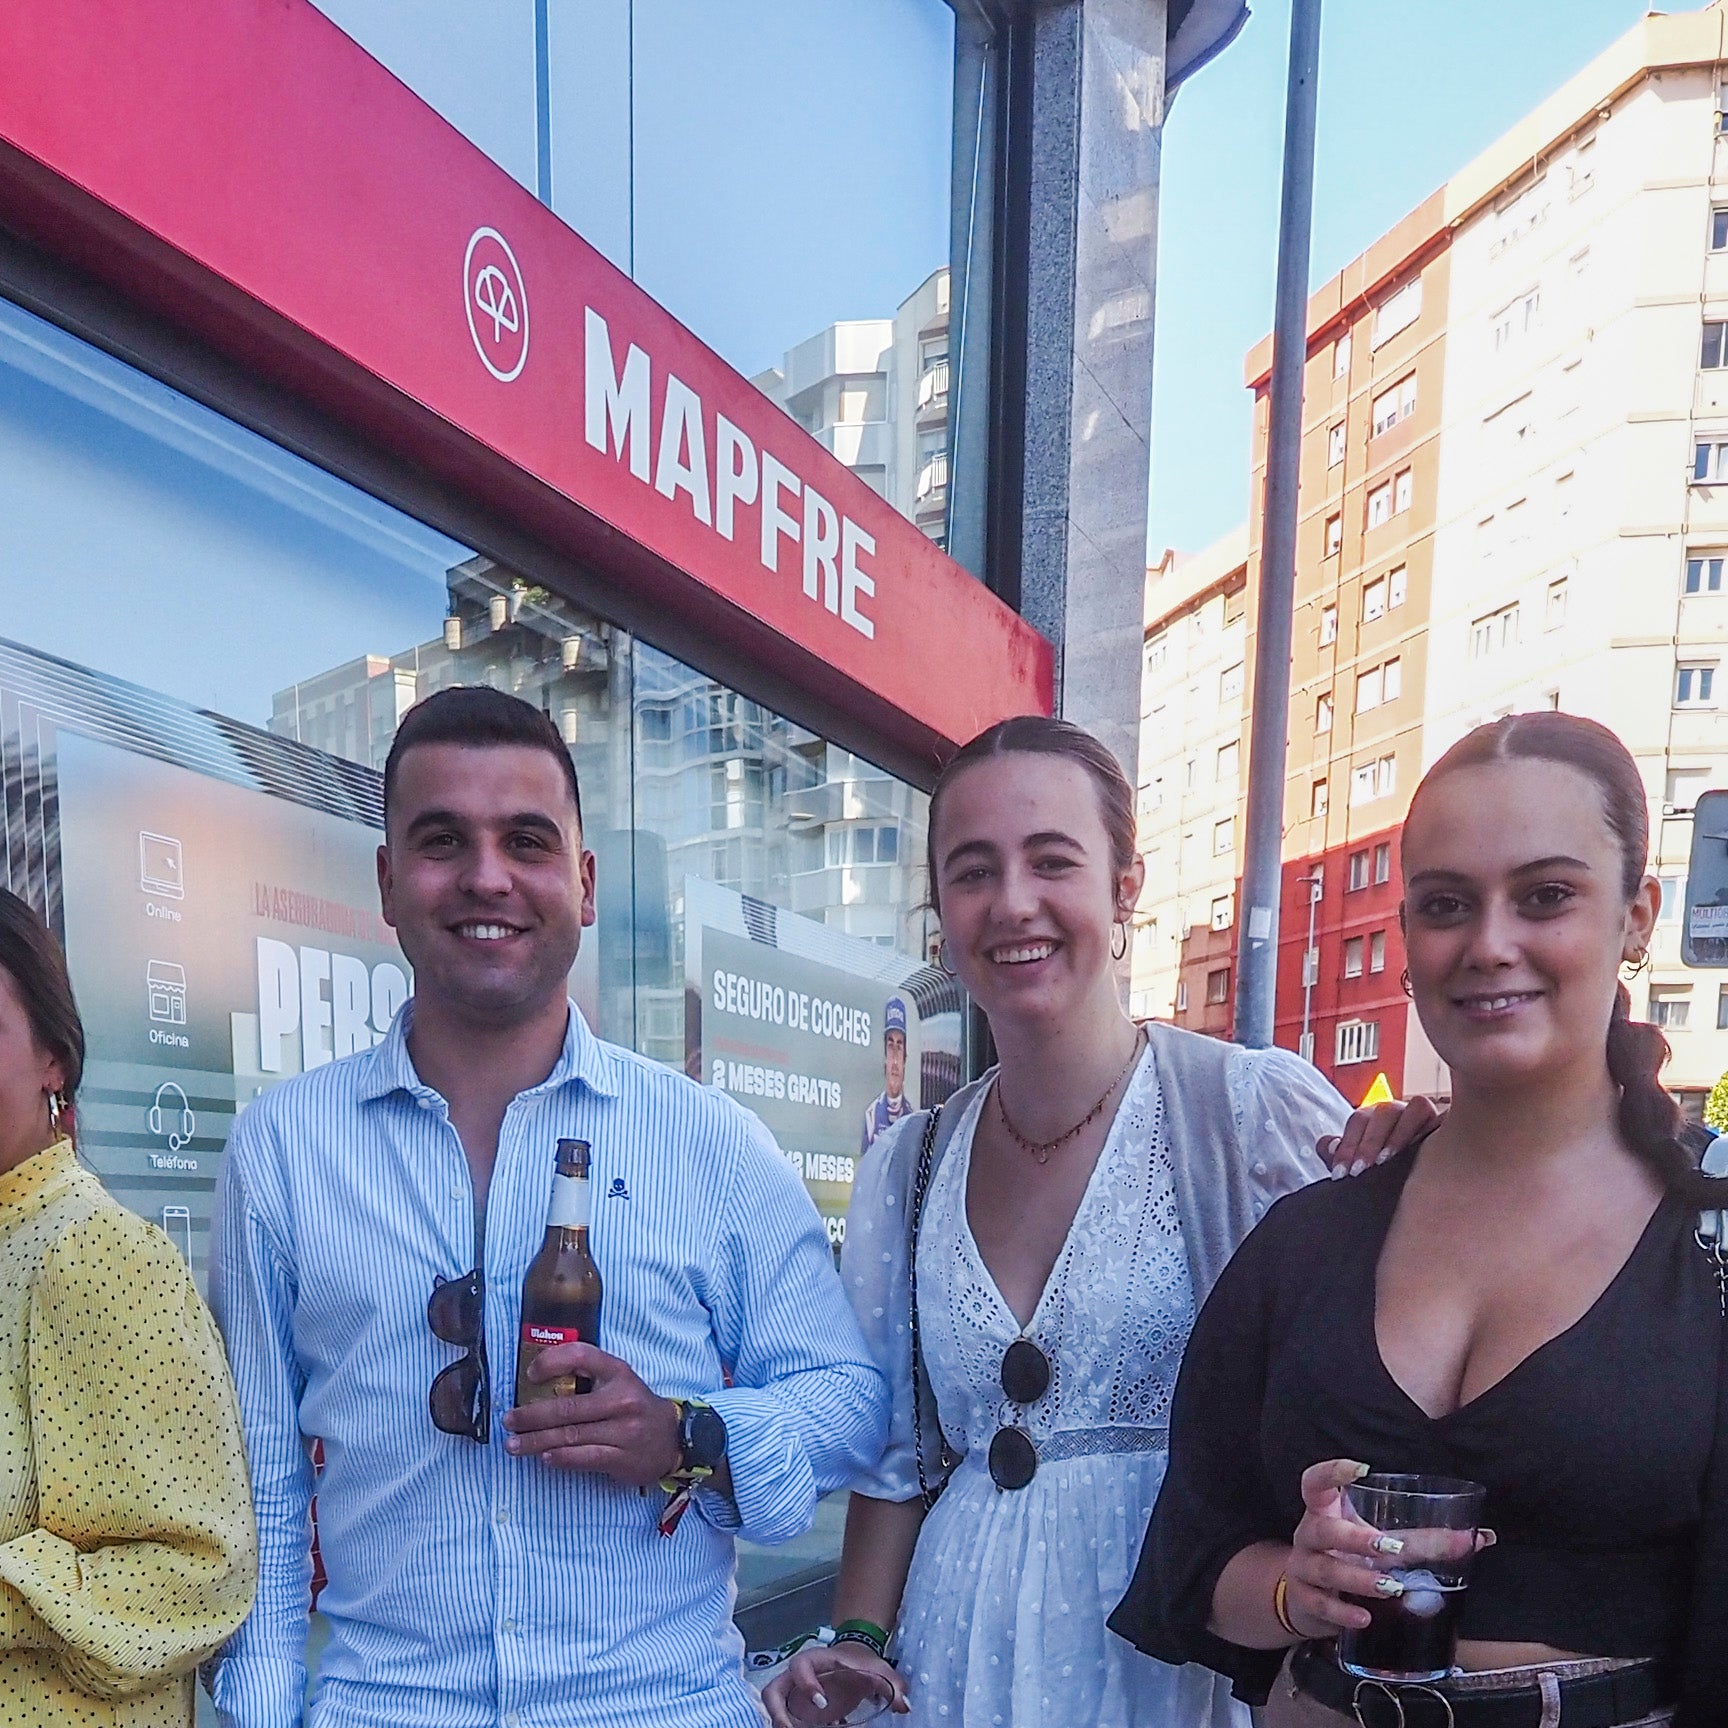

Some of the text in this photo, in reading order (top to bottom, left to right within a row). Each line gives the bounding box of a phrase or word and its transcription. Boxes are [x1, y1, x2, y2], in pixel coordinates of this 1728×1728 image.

[584, 304, 876, 641] MAPFRE
[145, 902, 182, 922] Online
[256, 936, 415, 1073] PERS
[713, 969, 871, 1047] SEGURO DE COCHES
[149, 1029, 190, 1048] Oficina
[712, 1059, 842, 1109] 2 MESES GRATIS
[151, 1154, 198, 1170] Teléfono
[805, 1152, 855, 1184] MESES
[530, 1327, 564, 1341] Mahou
